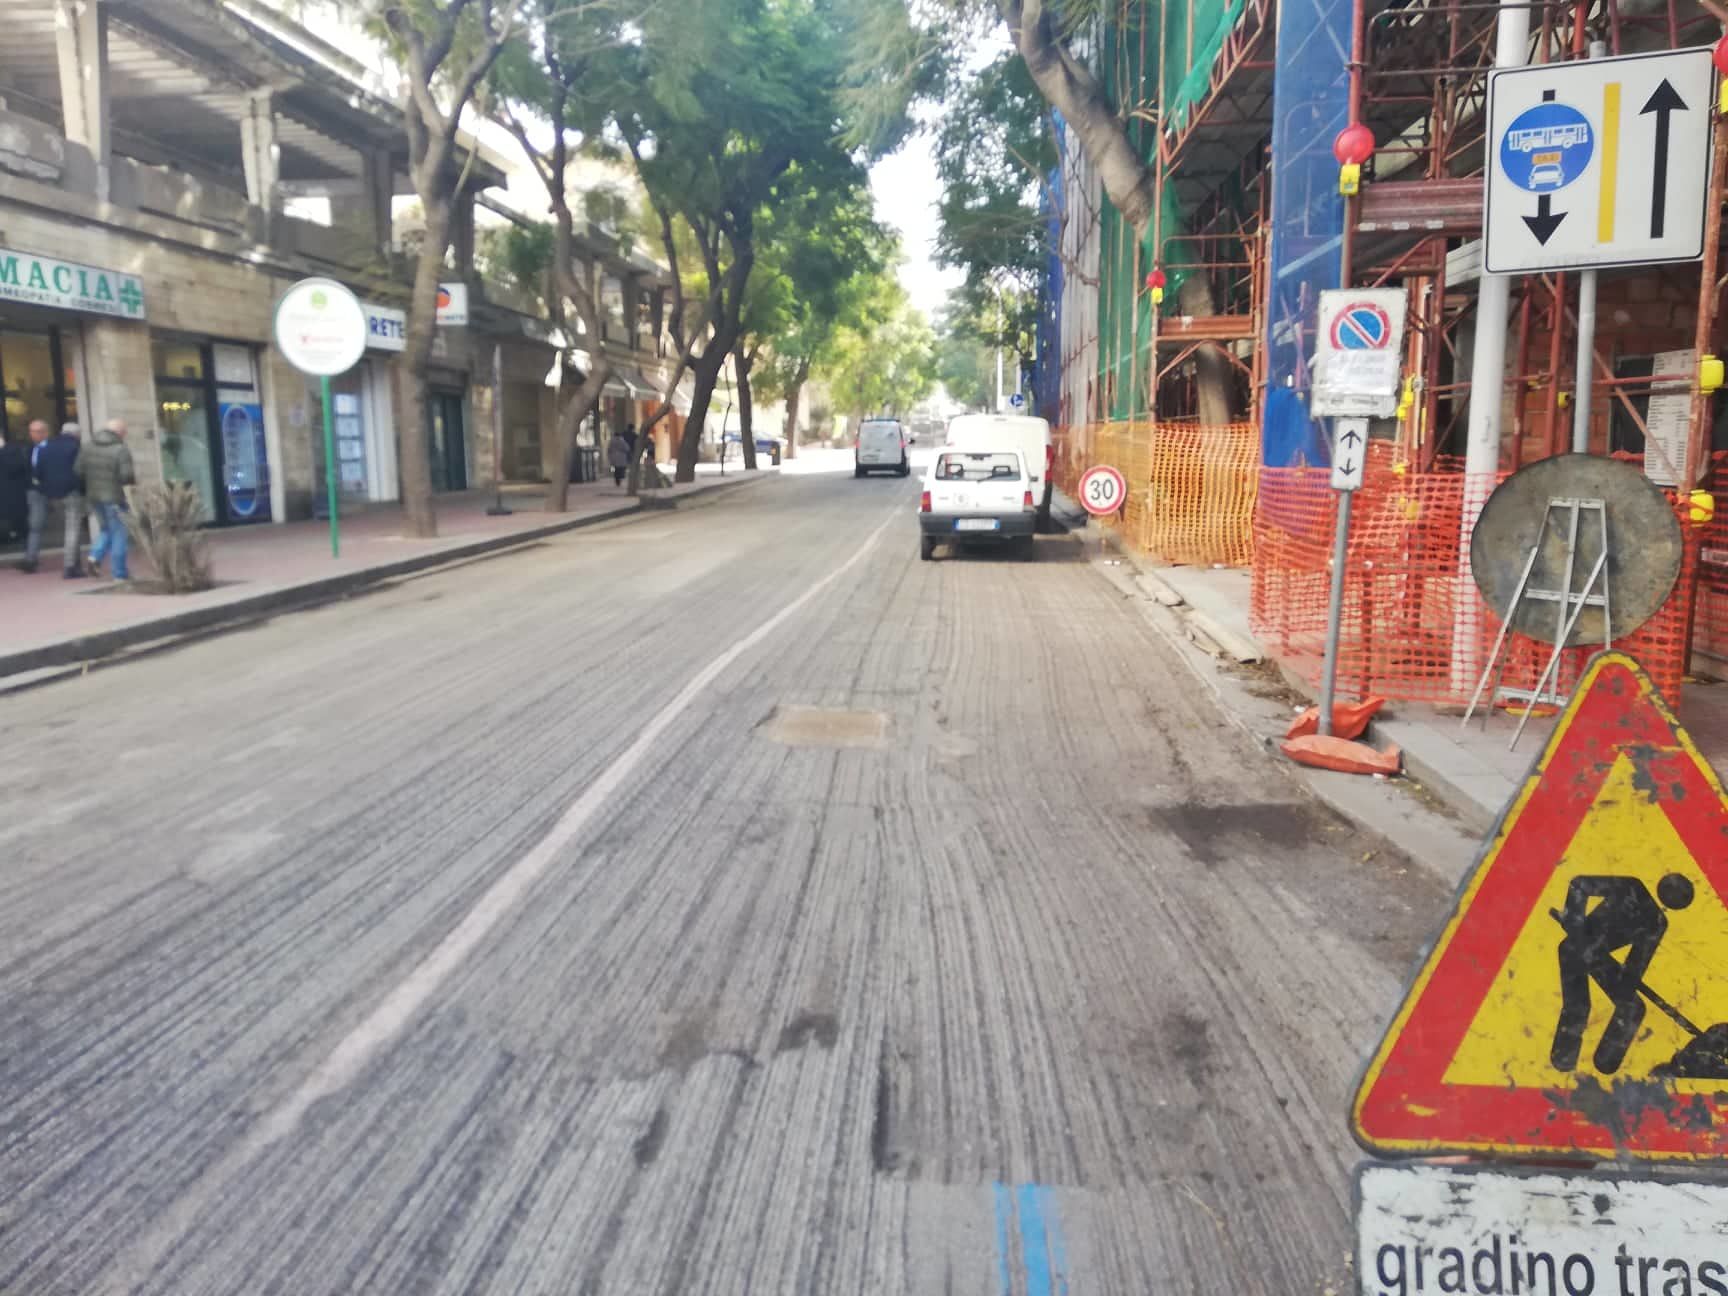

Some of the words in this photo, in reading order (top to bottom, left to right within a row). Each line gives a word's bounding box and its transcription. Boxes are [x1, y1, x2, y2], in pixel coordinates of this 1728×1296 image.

[0, 256, 113, 300] MACIA
[369, 316, 404, 339] RETE
[1090, 479, 1114, 500] 30
[1376, 1233, 1595, 1296] gradino
[1614, 1241, 1728, 1296] tras
